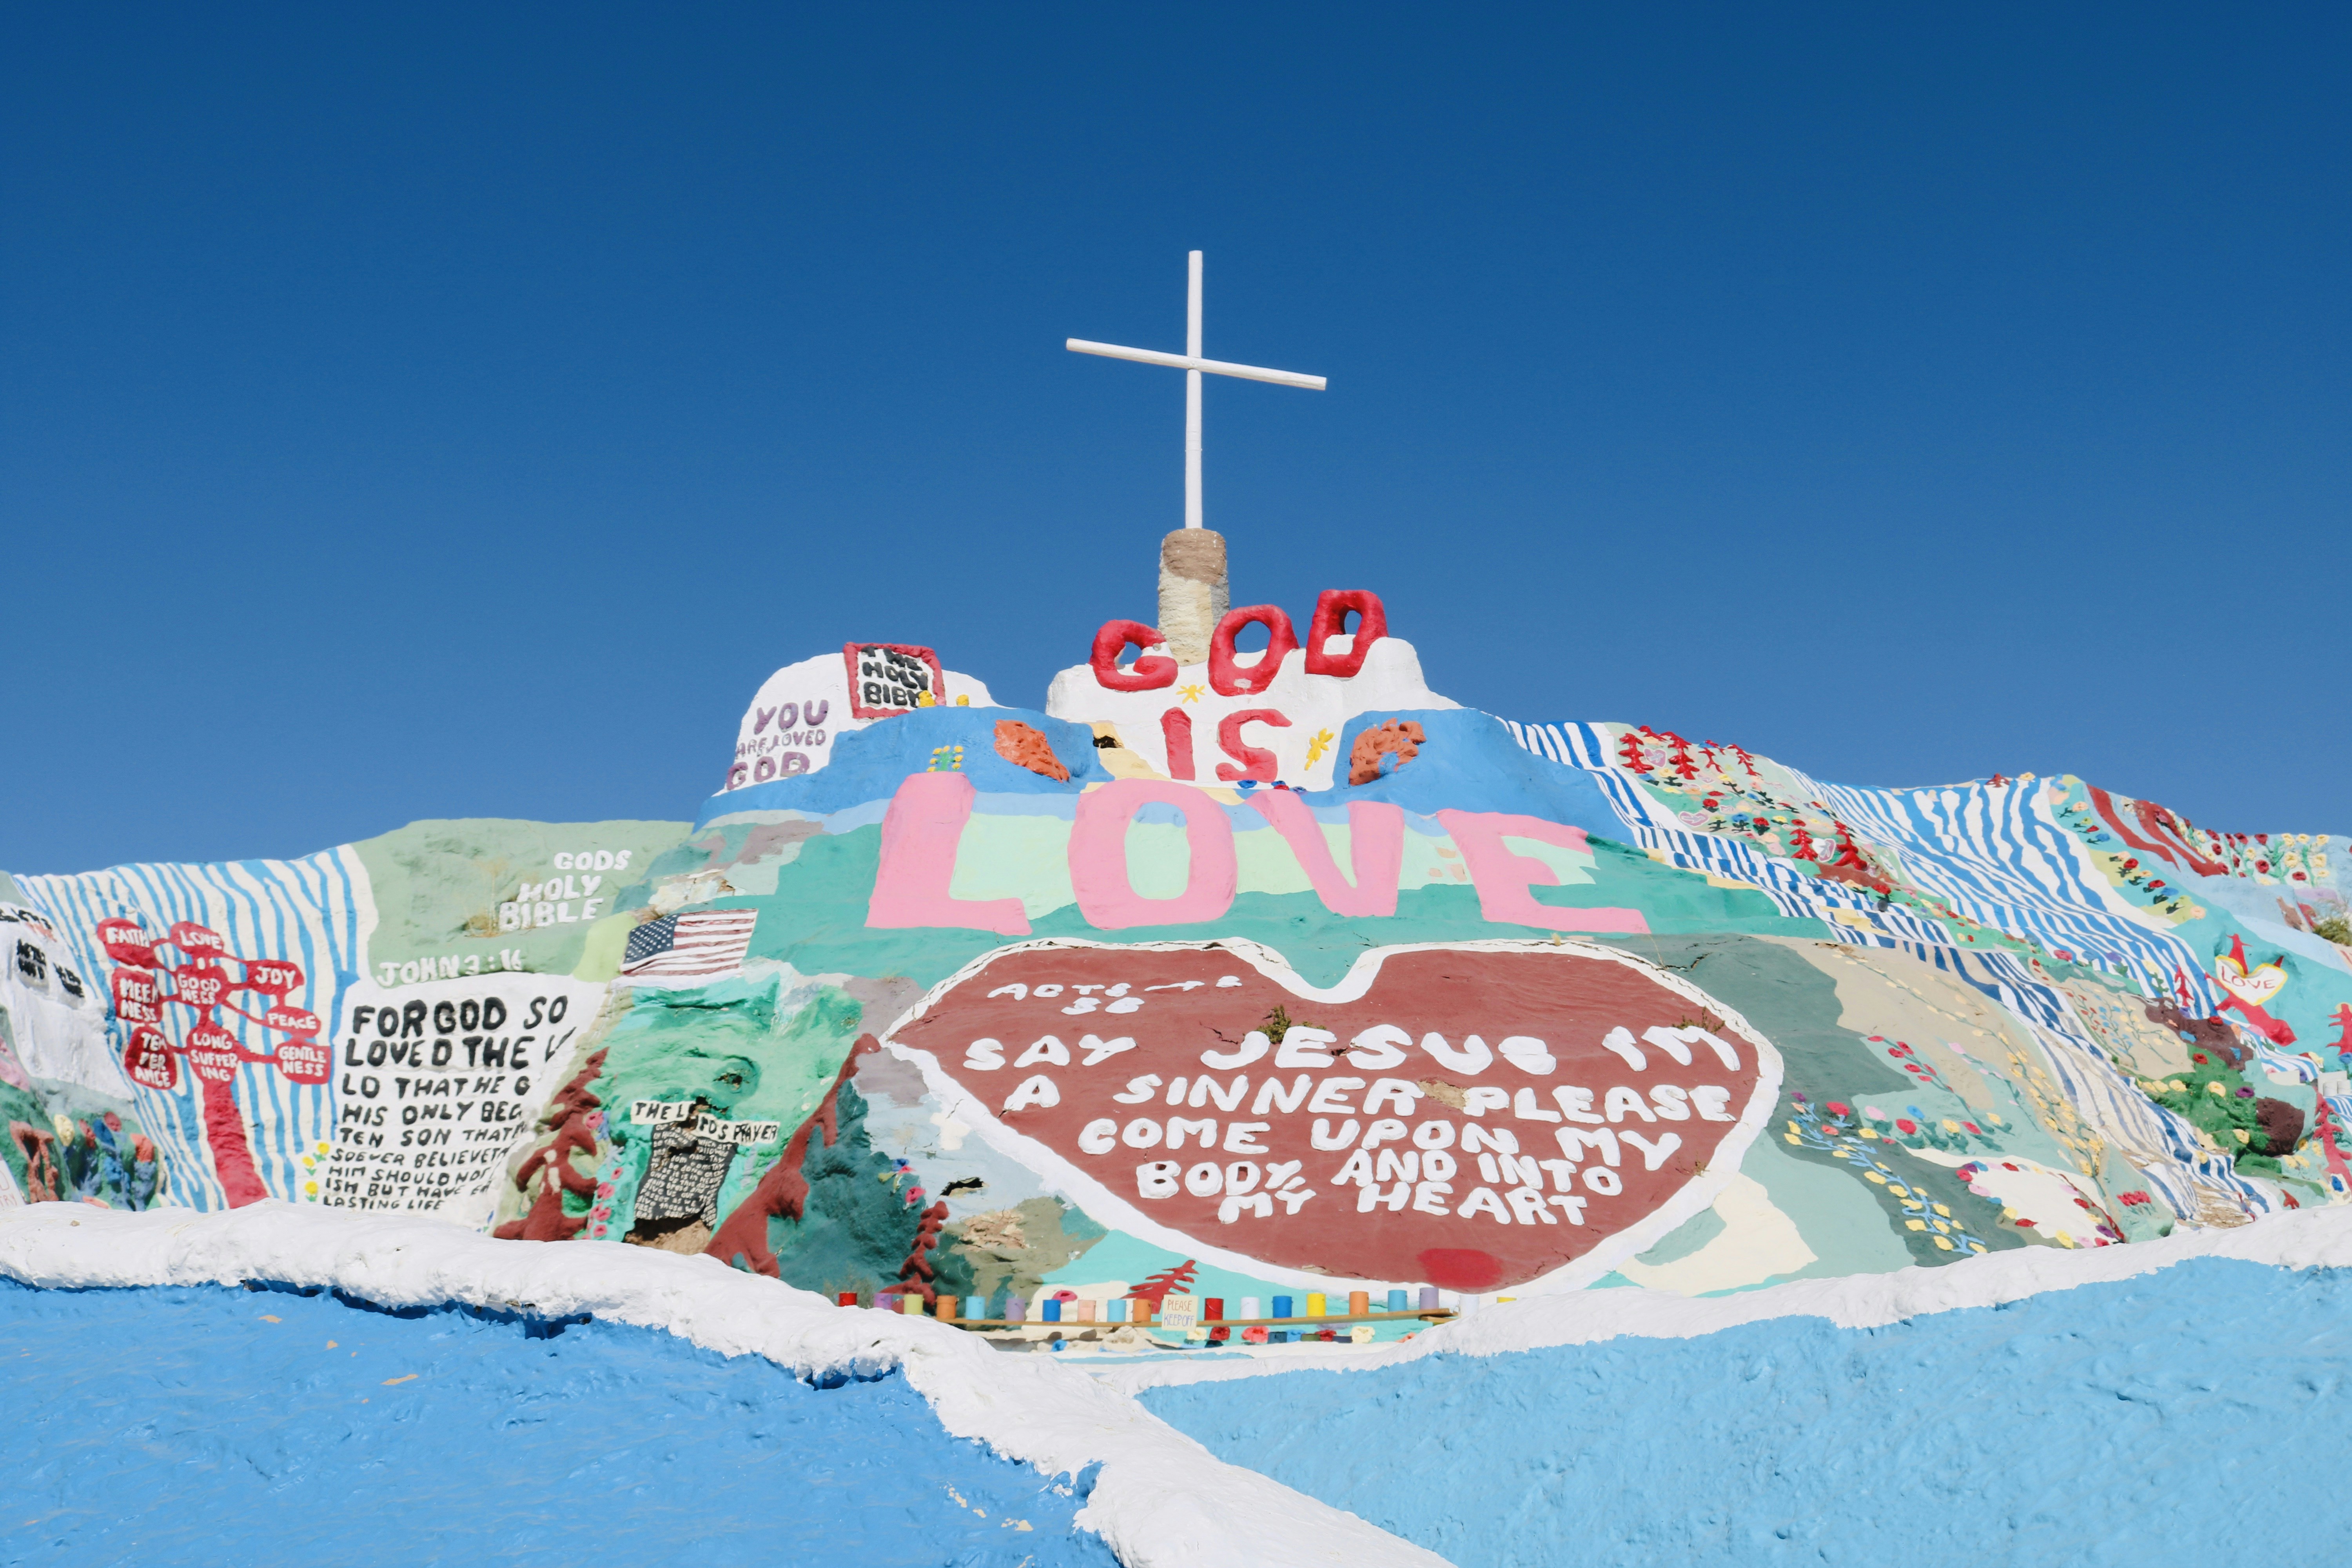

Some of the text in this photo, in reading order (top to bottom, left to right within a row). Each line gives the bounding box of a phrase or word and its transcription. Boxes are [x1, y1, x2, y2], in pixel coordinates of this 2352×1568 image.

[1089, 590, 1388, 696] GOD
[861, 646, 923, 671] THE
[862, 662, 928, 690] HOLY
[753, 699, 829, 735] YOU
[735, 729, 826, 757] ARE LOVED
[1160, 706, 1292, 782] IS
[726, 751, 810, 790] GOD
[554, 850, 632, 871] GODS
[864, 772, 1651, 936] LOVE
[517, 875, 602, 902] HOLY
[498, 898, 604, 932] BIBLE
[106, 927, 150, 948] FAITH
[179, 930, 222, 950] LOVE
[255, 966, 297, 989] JOY
[376, 954, 460, 987] JOHN
[2221, 965, 2276, 989] LOVE
[178, 973, 221, 992] GOOD
[987, 982, 1132, 1001] ACTS
[181, 989, 216, 1004] NESS
[120, 999, 157, 1022] NESS
[267, 1012, 317, 1030] PEACE
[353, 995, 568, 1038] FOR GOD SO
[192, 1032, 233, 1050] LONG
[345, 1038, 453, 1067] LOVED
[463, 1035, 535, 1069] THE
[963, 1034, 1136, 1071] SAY
[1200, 1024, 1557, 1075] JESUS
[191, 1049, 238, 1068] SUFFER
[279, 1046, 327, 1063] GENTLE
[134, 1065, 171, 1087] ANCE
[200, 1066, 231, 1082] ING
[283, 1062, 324, 1076] NESS
[395, 1076, 468, 1098] THAT
[473, 1075, 506, 1095] HE
[1002, 1073, 1737, 1124] A SINNER PLEASE
[343, 1103, 388, 1126] HIS
[402, 1101, 475, 1126] ONLY
[636, 1102, 671, 1120] THE
[733, 1123, 778, 1142] PRAYER
[339, 1127, 384, 1148] TEN
[400, 1127, 452, 1147] SON
[1078, 1116, 1682, 1171] COME UPON MY
[330, 1148, 405, 1165] SOEVER
[329, 1165, 366, 1178] HIM
[370, 1167, 449, 1185] SHOULD
[1330, 1148, 1457, 1187] AND
[1477, 1152, 1622, 1196] INTO
[326, 1177, 359, 1195] ISH
[368, 1182, 407, 1197] BUT
[417, 1182, 462, 1197] HAVE
[323, 1194, 445, 1210] LASTING LIFE
[1218, 1180, 1588, 1225] MY HEART
[1167, 1299, 1192, 1312] PLEASE
[1163, 1313, 1194, 1327] KEEP OFF
